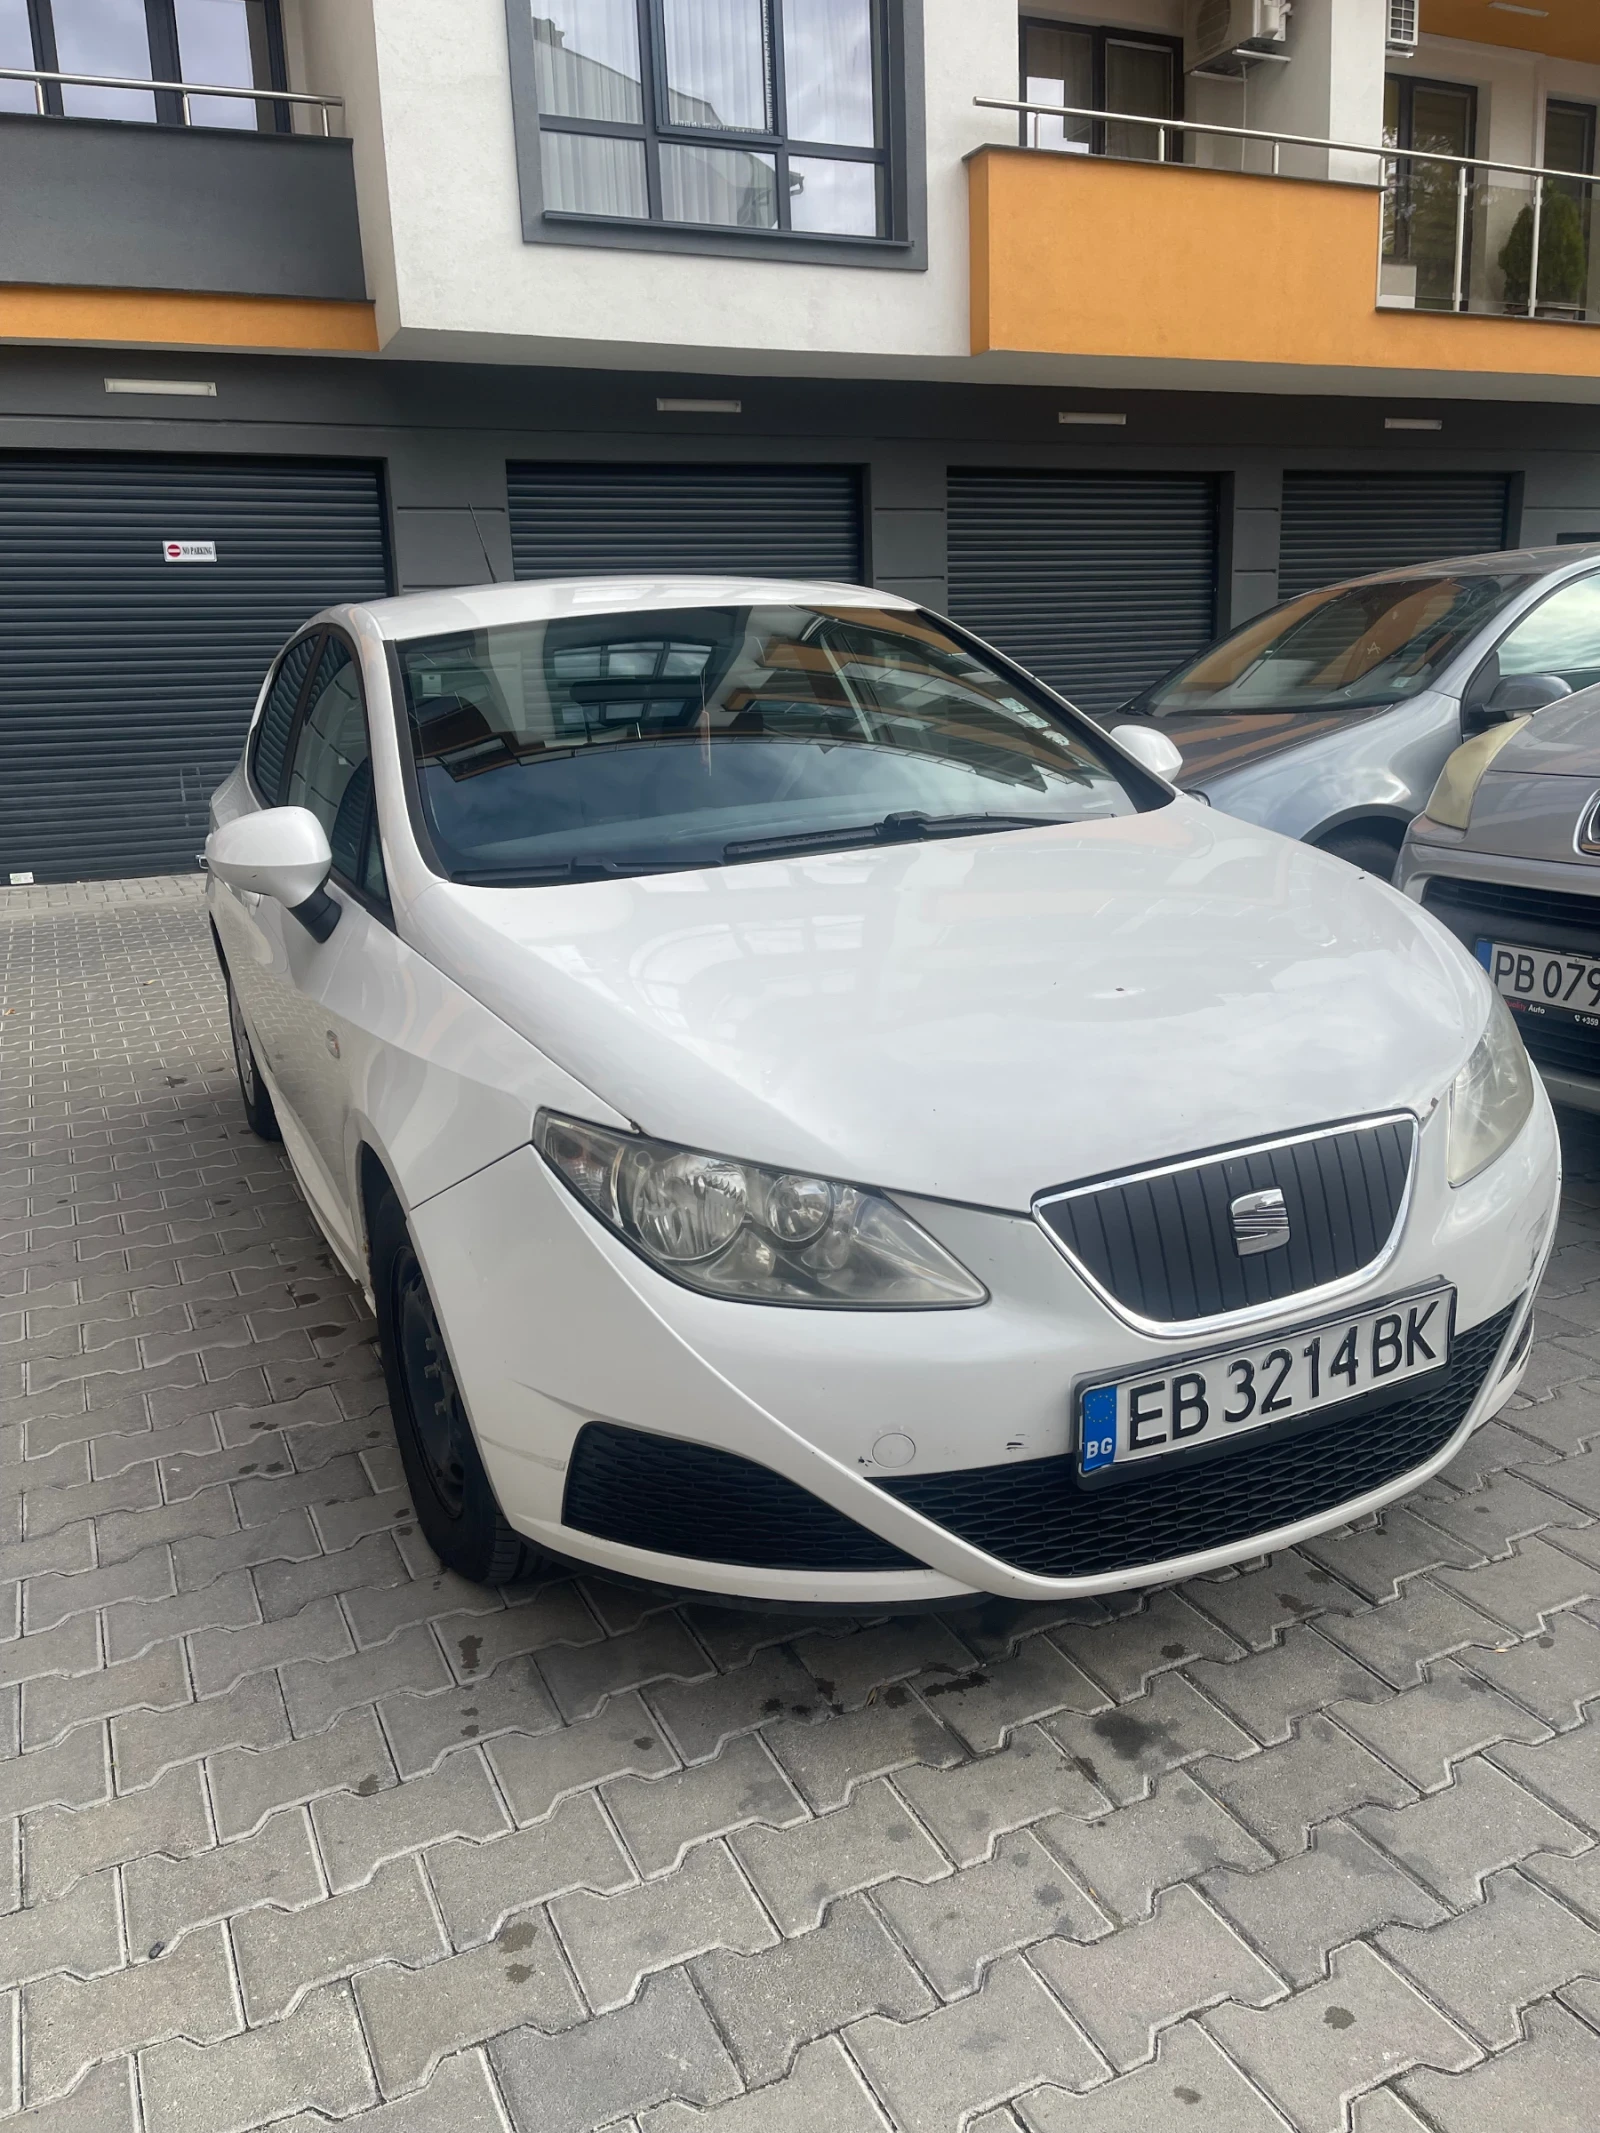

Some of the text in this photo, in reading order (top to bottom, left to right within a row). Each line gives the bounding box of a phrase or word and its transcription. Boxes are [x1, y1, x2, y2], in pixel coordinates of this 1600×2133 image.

[182, 546, 213, 555] NO PARKING
[1495, 951, 1534, 993] PB
[1528, 1004, 1545, 1014] Auto
[1129, 1300, 1438, 1451] EB 3214 BK
[1086, 1437, 1113, 1459] BG
